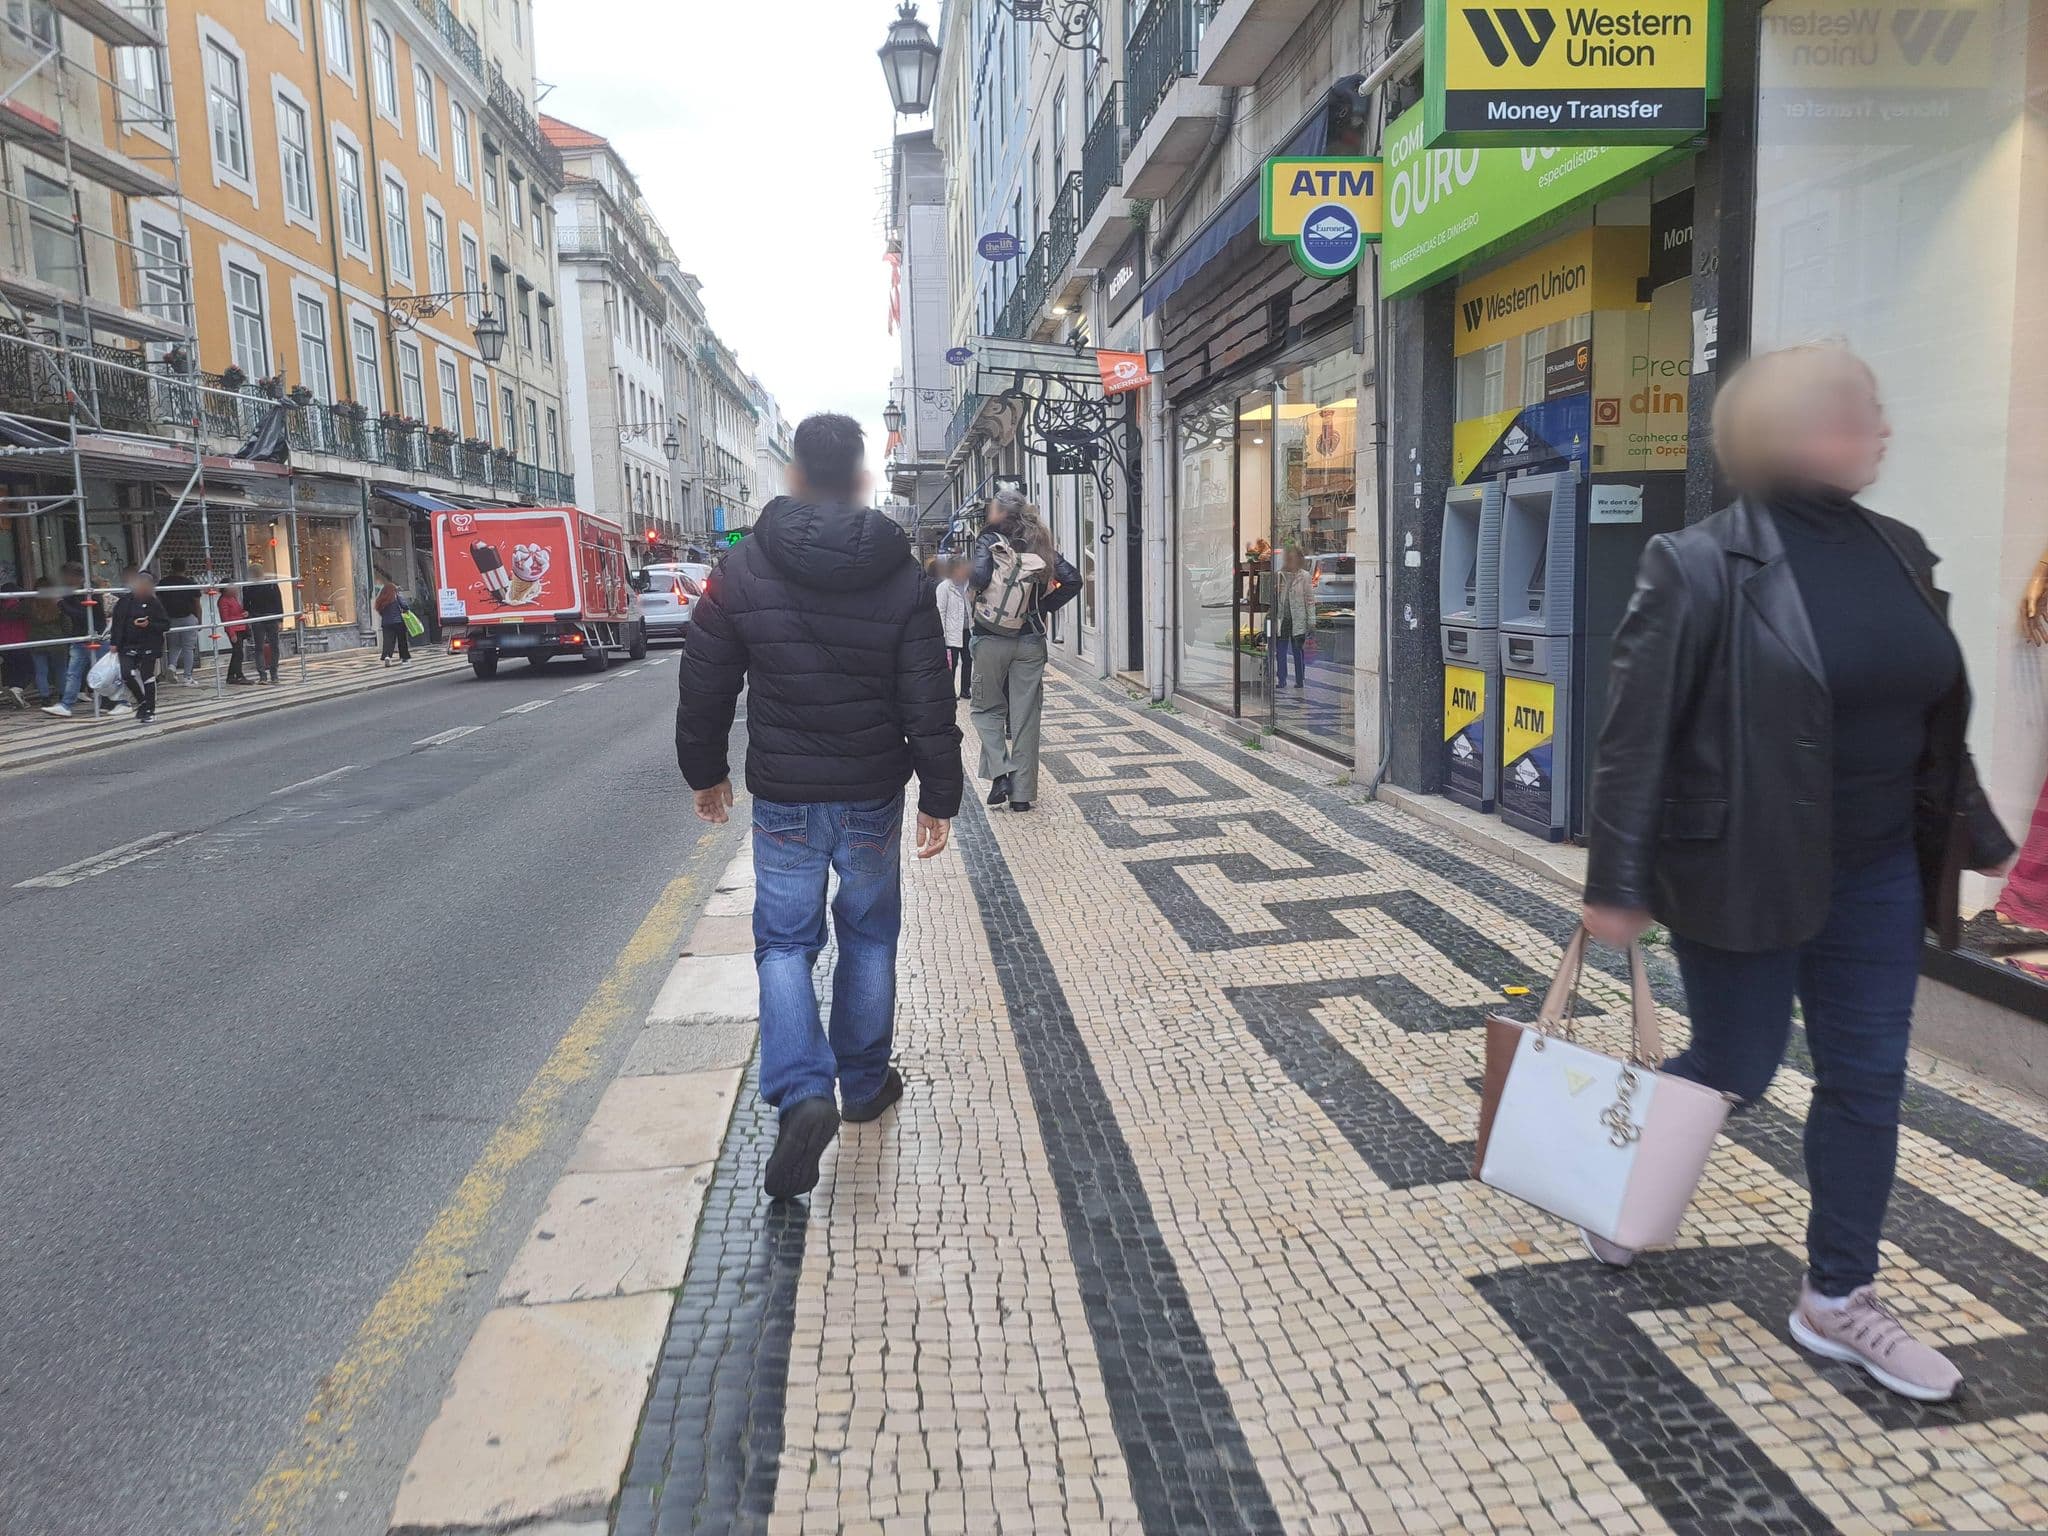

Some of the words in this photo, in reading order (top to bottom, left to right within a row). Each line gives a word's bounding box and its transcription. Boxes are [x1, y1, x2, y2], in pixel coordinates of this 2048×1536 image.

[1566, 8, 1692, 36] Western
[1566, 39, 1655, 67] Union
[1487, 101, 1562, 123] Money
[1567, 99, 1663, 120] Transfer
[1538, 148, 1599, 188] especialistas
[1289, 170, 1375, 197] ATM
[1390, 147, 1480, 228] OURO
[1315, 224, 1346, 233] Euronet
[1437, 230, 1447, 247] DE
[1446, 212, 1480, 241] DINHEIRO
[1485, 282, 1539, 322] Western
[1541, 264, 1586, 300] Union
[1109, 375, 1152, 391] MERRELL
[1629, 385, 1684, 414] din
[1628, 432, 1679, 445] Conheça
[1628, 448, 1652, 456] com
[1452, 687, 1477, 713] ATM
[1513, 706, 1545, 734] ATM
